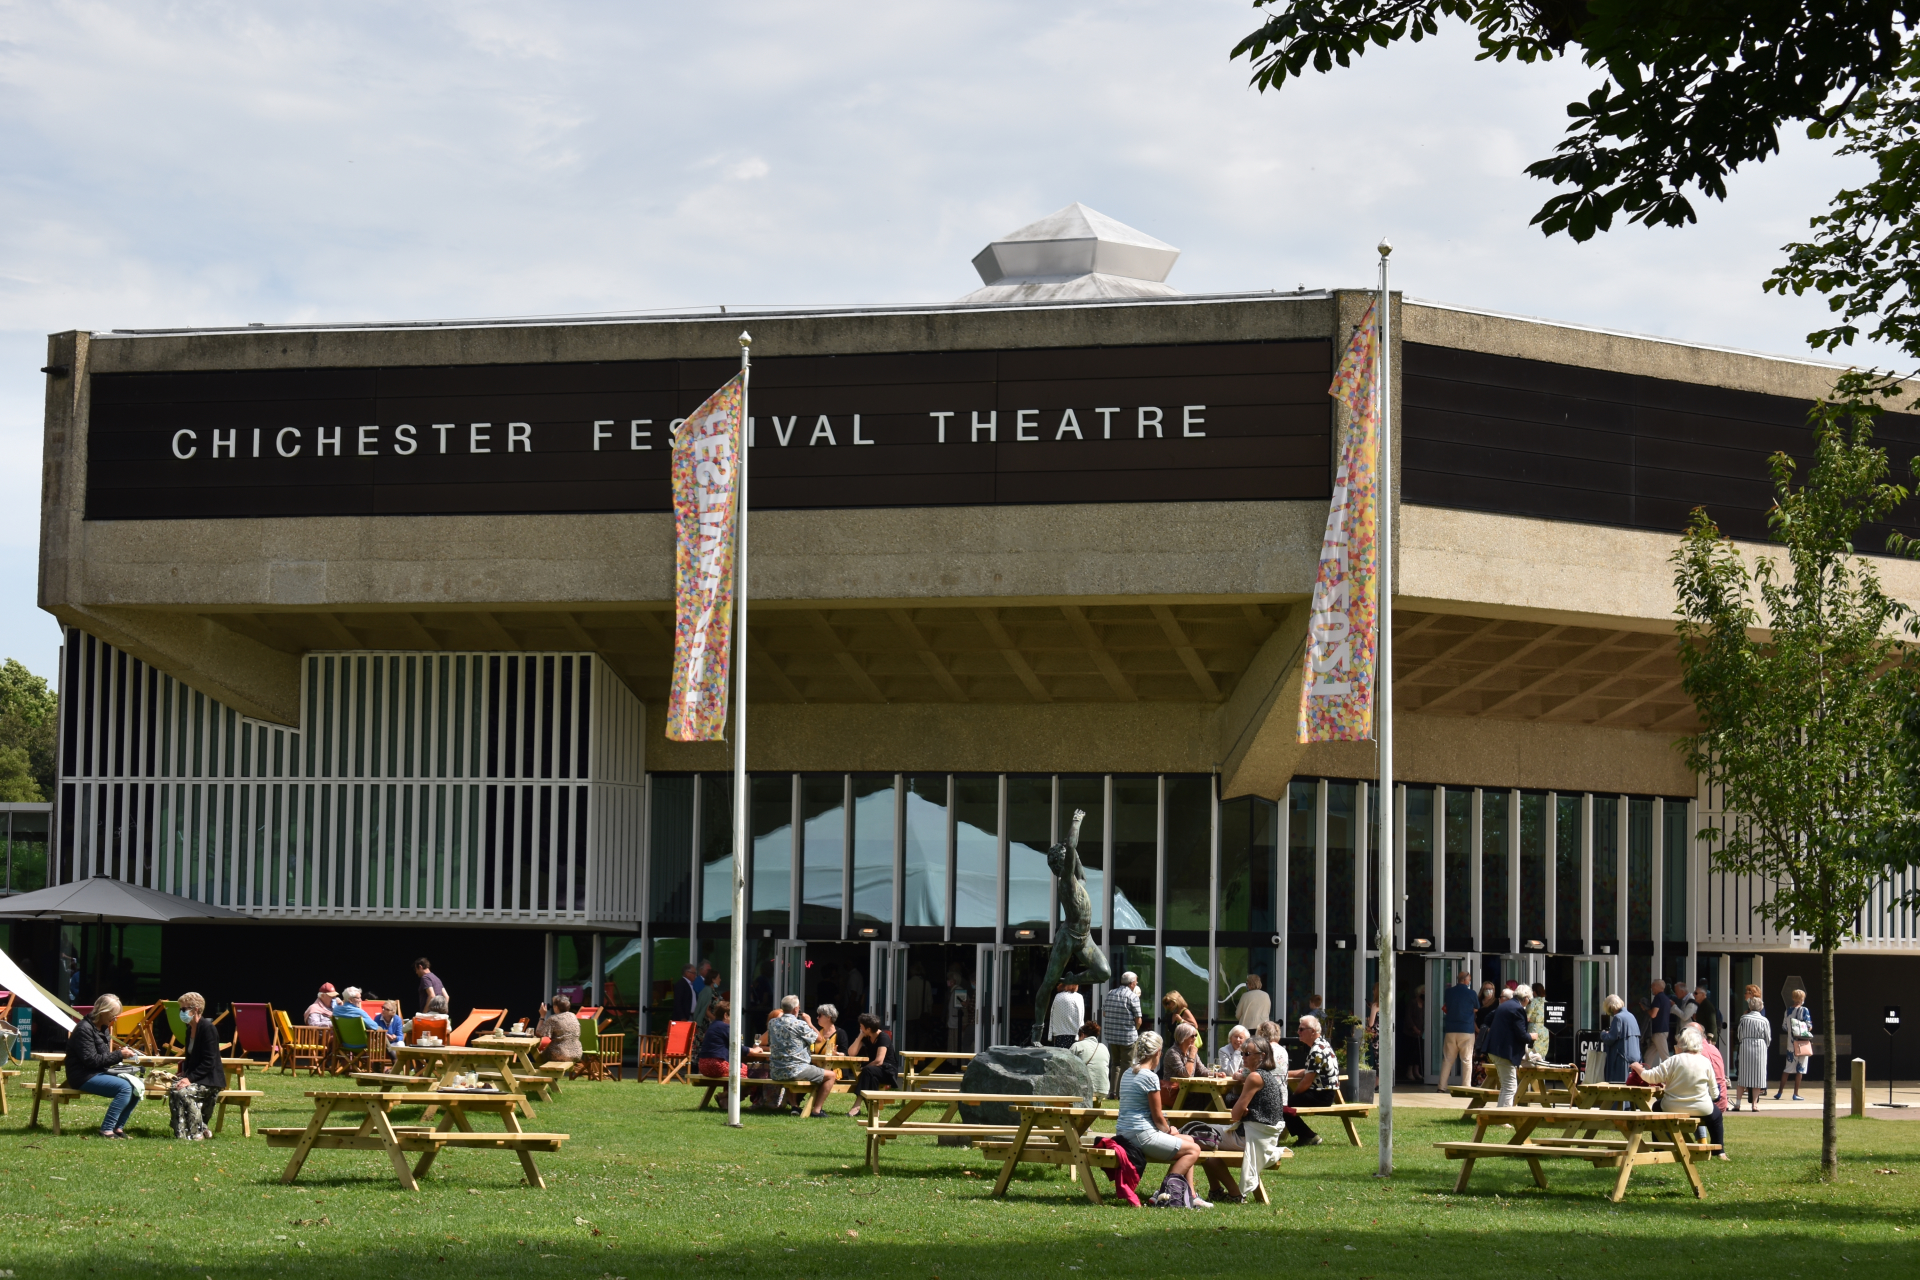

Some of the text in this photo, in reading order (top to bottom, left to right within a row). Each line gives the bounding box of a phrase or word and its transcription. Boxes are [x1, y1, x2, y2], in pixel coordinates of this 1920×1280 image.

[171, 404, 1207, 460] CHICHESTER FESIVAL THEATRE
